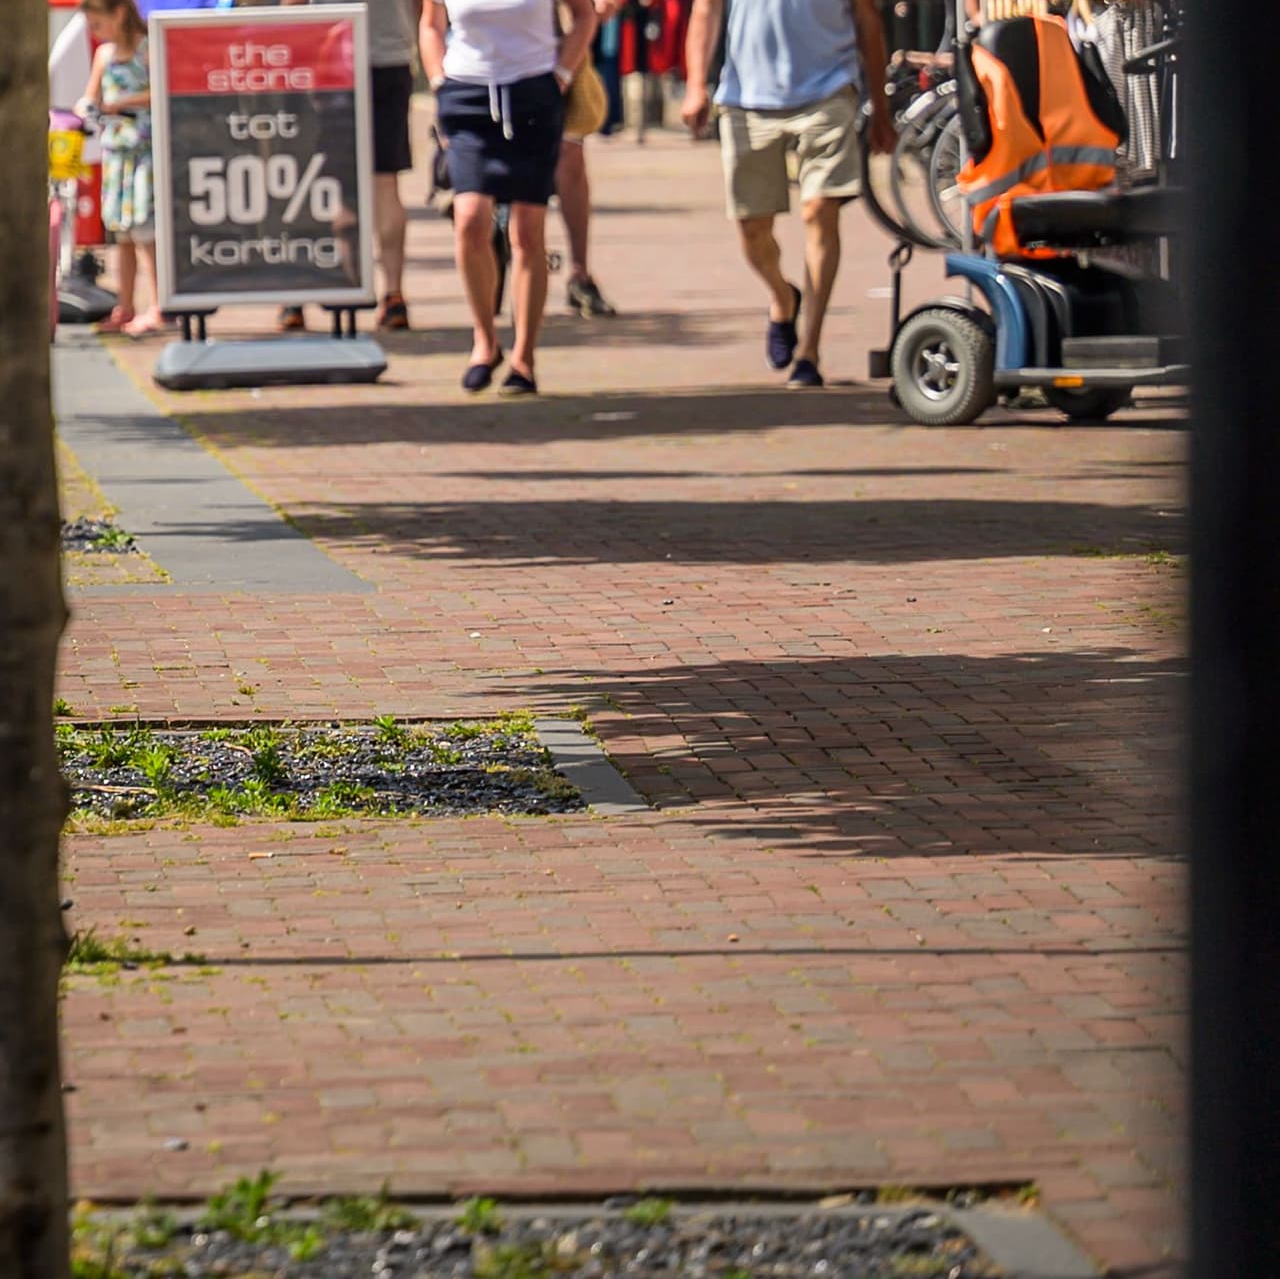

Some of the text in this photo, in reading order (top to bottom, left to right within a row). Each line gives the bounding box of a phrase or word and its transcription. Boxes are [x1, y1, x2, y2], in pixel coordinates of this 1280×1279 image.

[228, 41, 290, 67] the
[207, 66, 315, 92] stone
[225, 109, 300, 140] tot
[188, 152, 342, 225] 50%
[190, 232, 342, 269] korting
